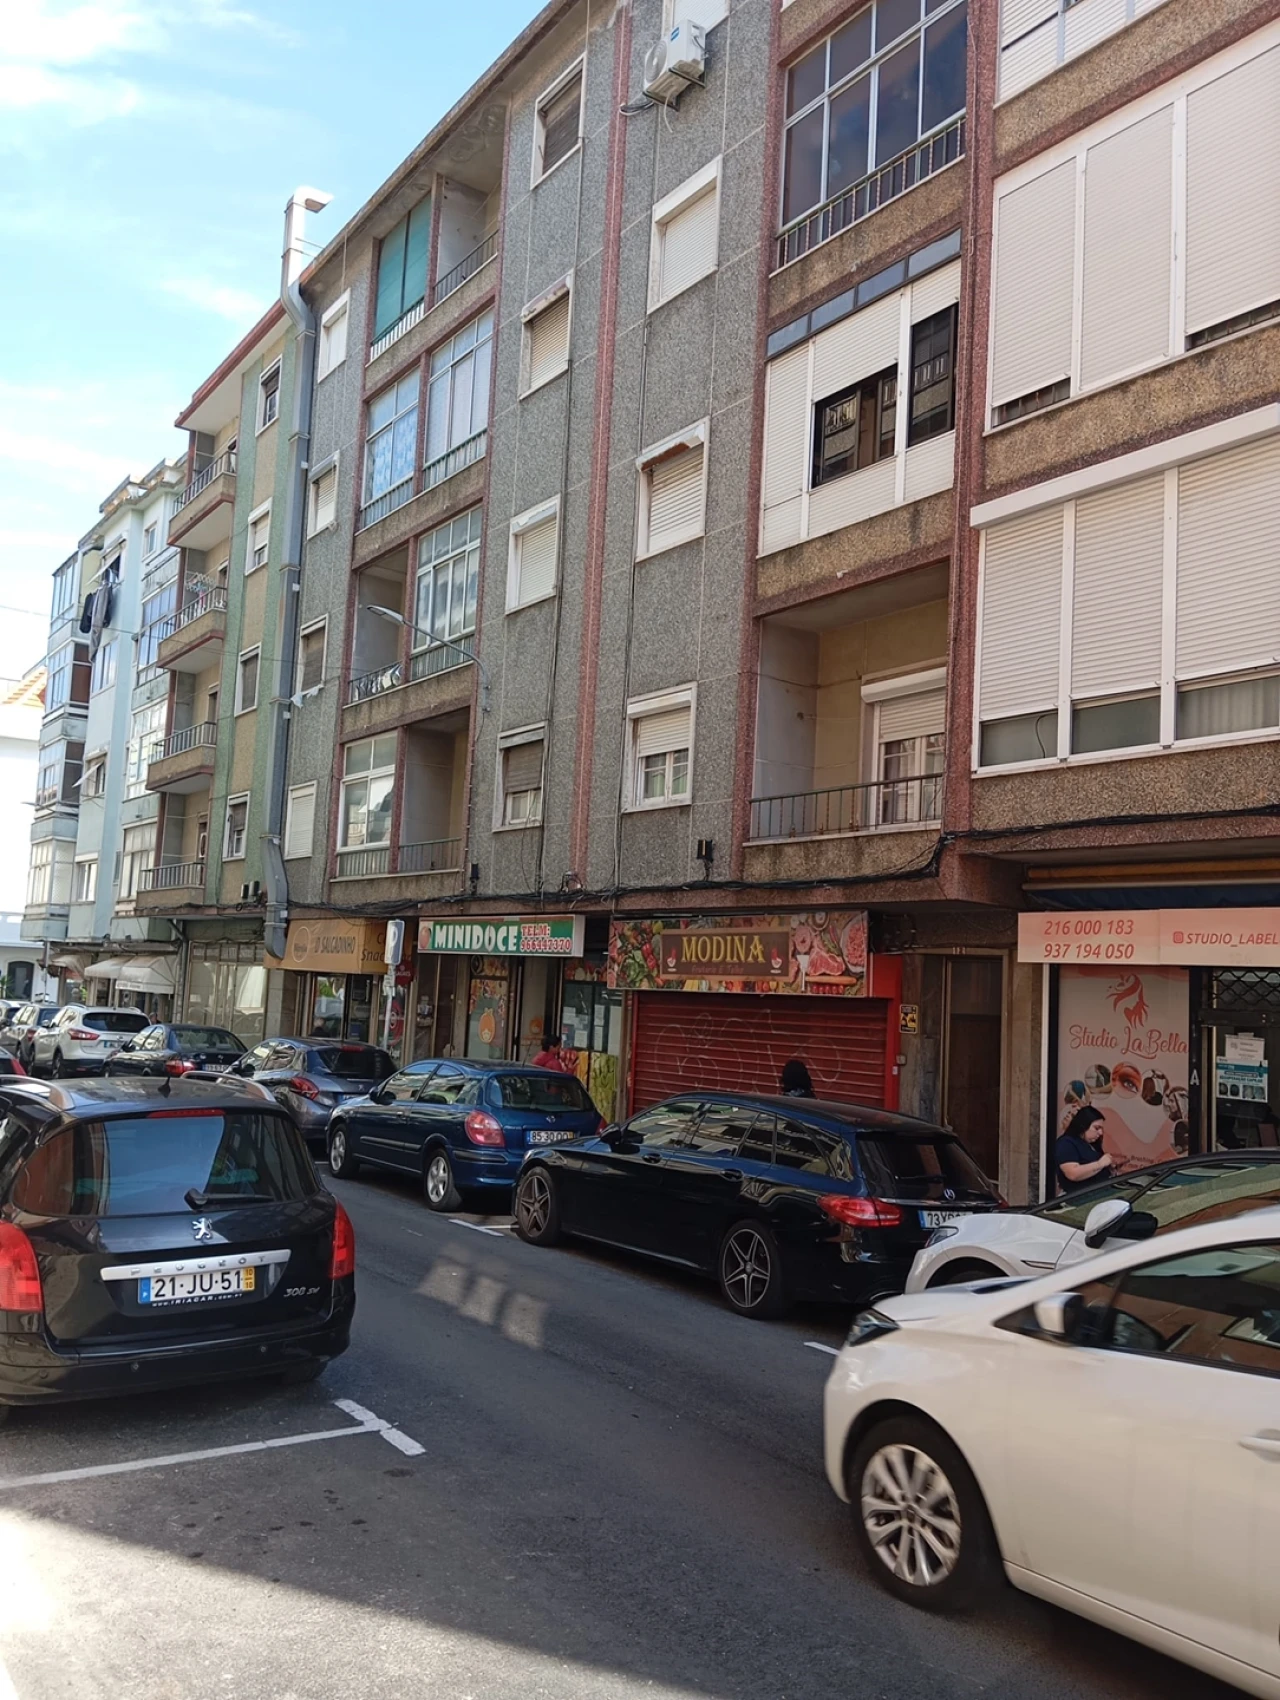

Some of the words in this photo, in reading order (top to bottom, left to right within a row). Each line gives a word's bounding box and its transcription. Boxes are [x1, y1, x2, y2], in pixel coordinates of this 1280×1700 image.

[521, 924, 550, 937] TELM:
[1044, 920, 1070, 935] 216
[1074, 920, 1101, 935] 000
[1107, 919, 1134, 934] 183
[434, 924, 518, 951] MINIDOCE
[521, 938, 572, 951] 966447370
[681, 935, 766, 963] MODINA
[1043, 943, 1070, 958] 937
[1075, 943, 1101, 958] 194
[1105, 943, 1134, 959] 050
[1069, 1024, 1118, 1049] Studio
[131, 1256, 265, 1276] PEUGEOT
